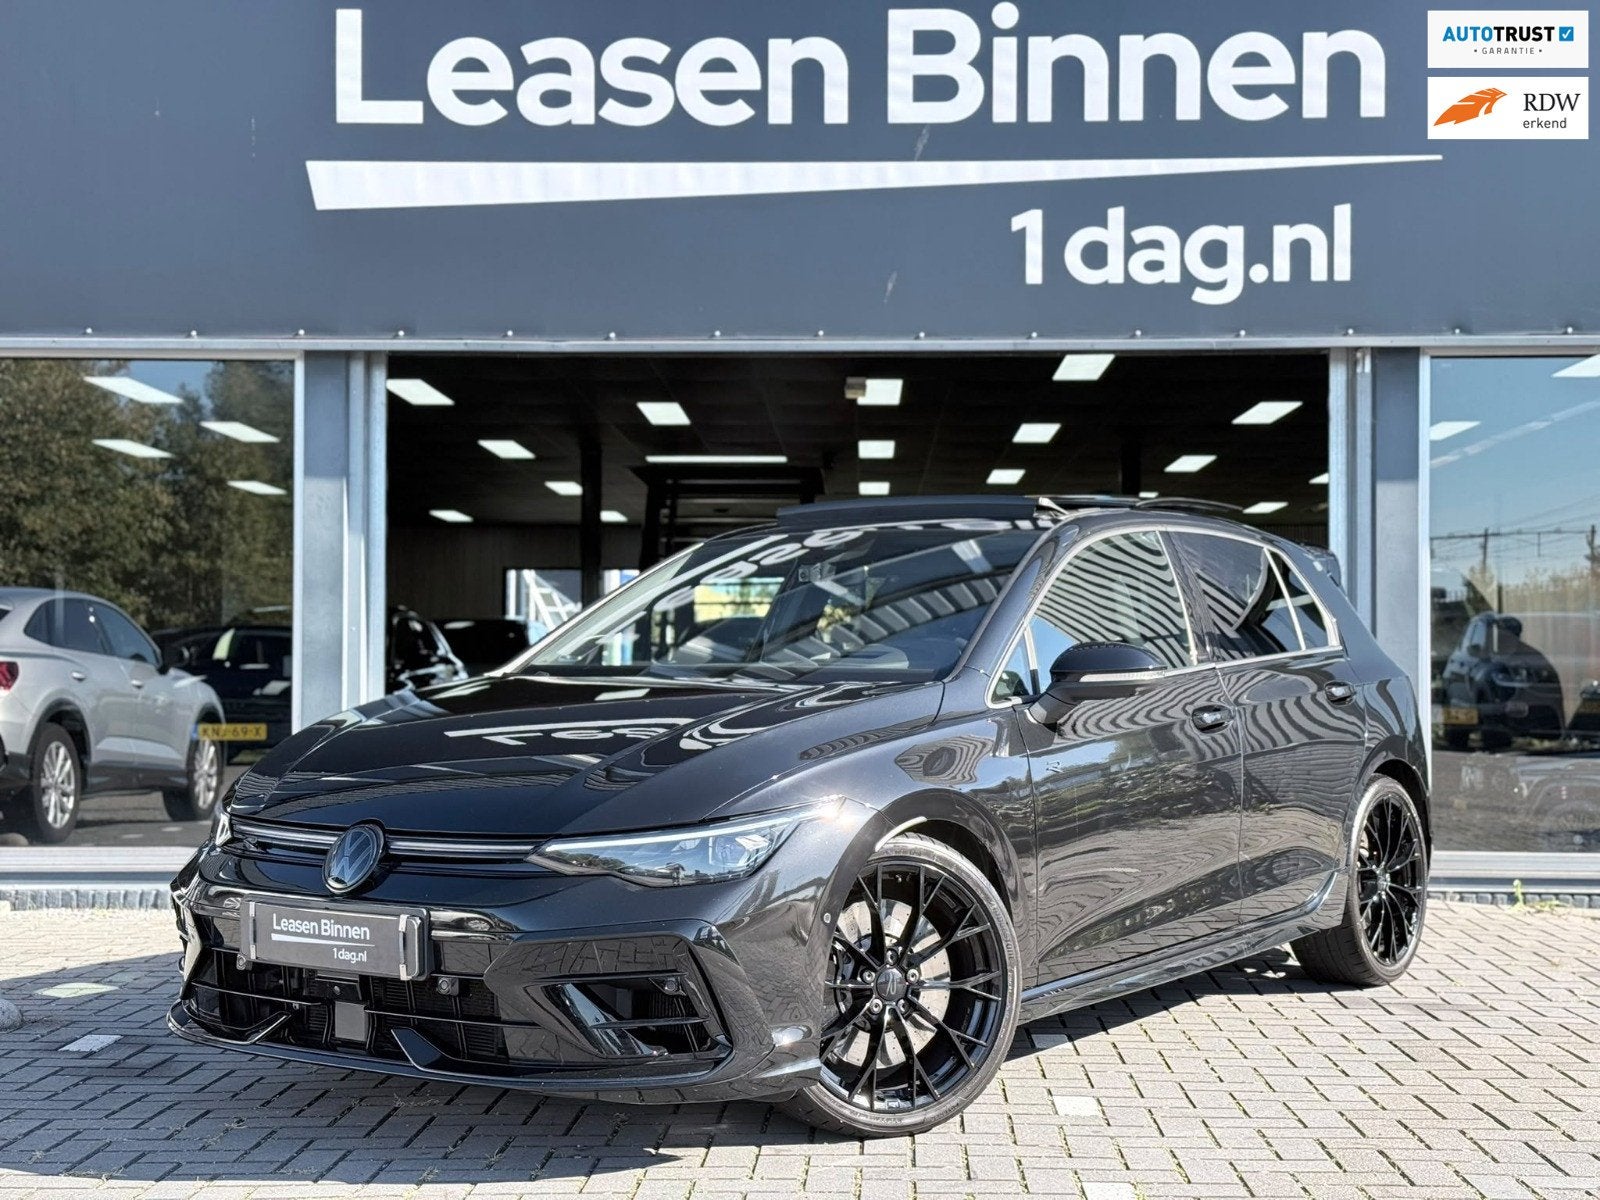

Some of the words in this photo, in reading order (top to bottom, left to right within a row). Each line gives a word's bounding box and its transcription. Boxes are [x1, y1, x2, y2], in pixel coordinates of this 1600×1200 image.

[335, 8, 849, 127] Leasen
[887, 1, 1386, 124] Binnen
[1010, 208, 1043, 285] 1
[1064, 203, 1352, 305] dag.nl
[272, 913, 319, 935] Leasen
[320, 919, 370, 941] Binnen
[332, 947, 339, 960] 1
[338, 949, 368, 964] dag.nl
